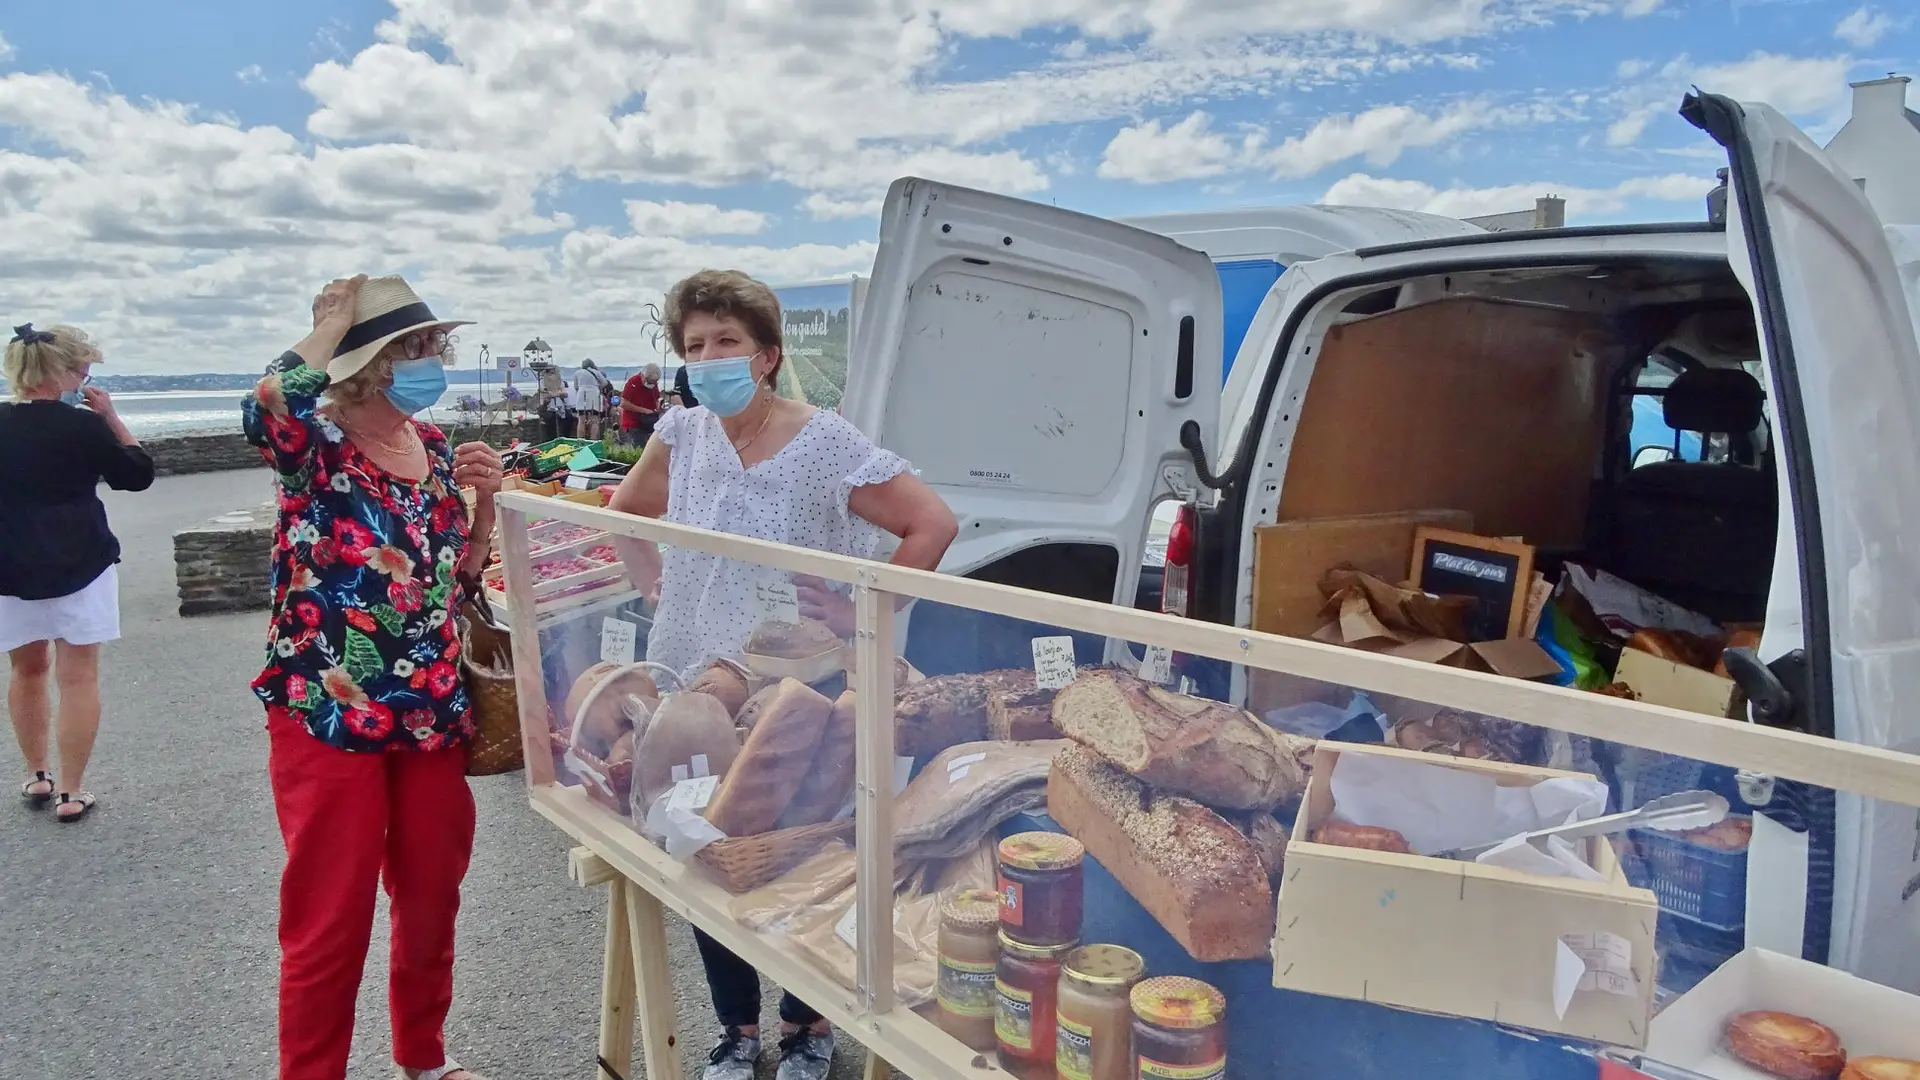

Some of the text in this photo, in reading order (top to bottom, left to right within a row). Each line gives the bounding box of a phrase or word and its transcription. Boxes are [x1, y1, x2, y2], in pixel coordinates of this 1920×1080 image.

[1435, 554, 1503, 577] Plat du jour
[1150, 1066, 1172, 1077] MIEL
